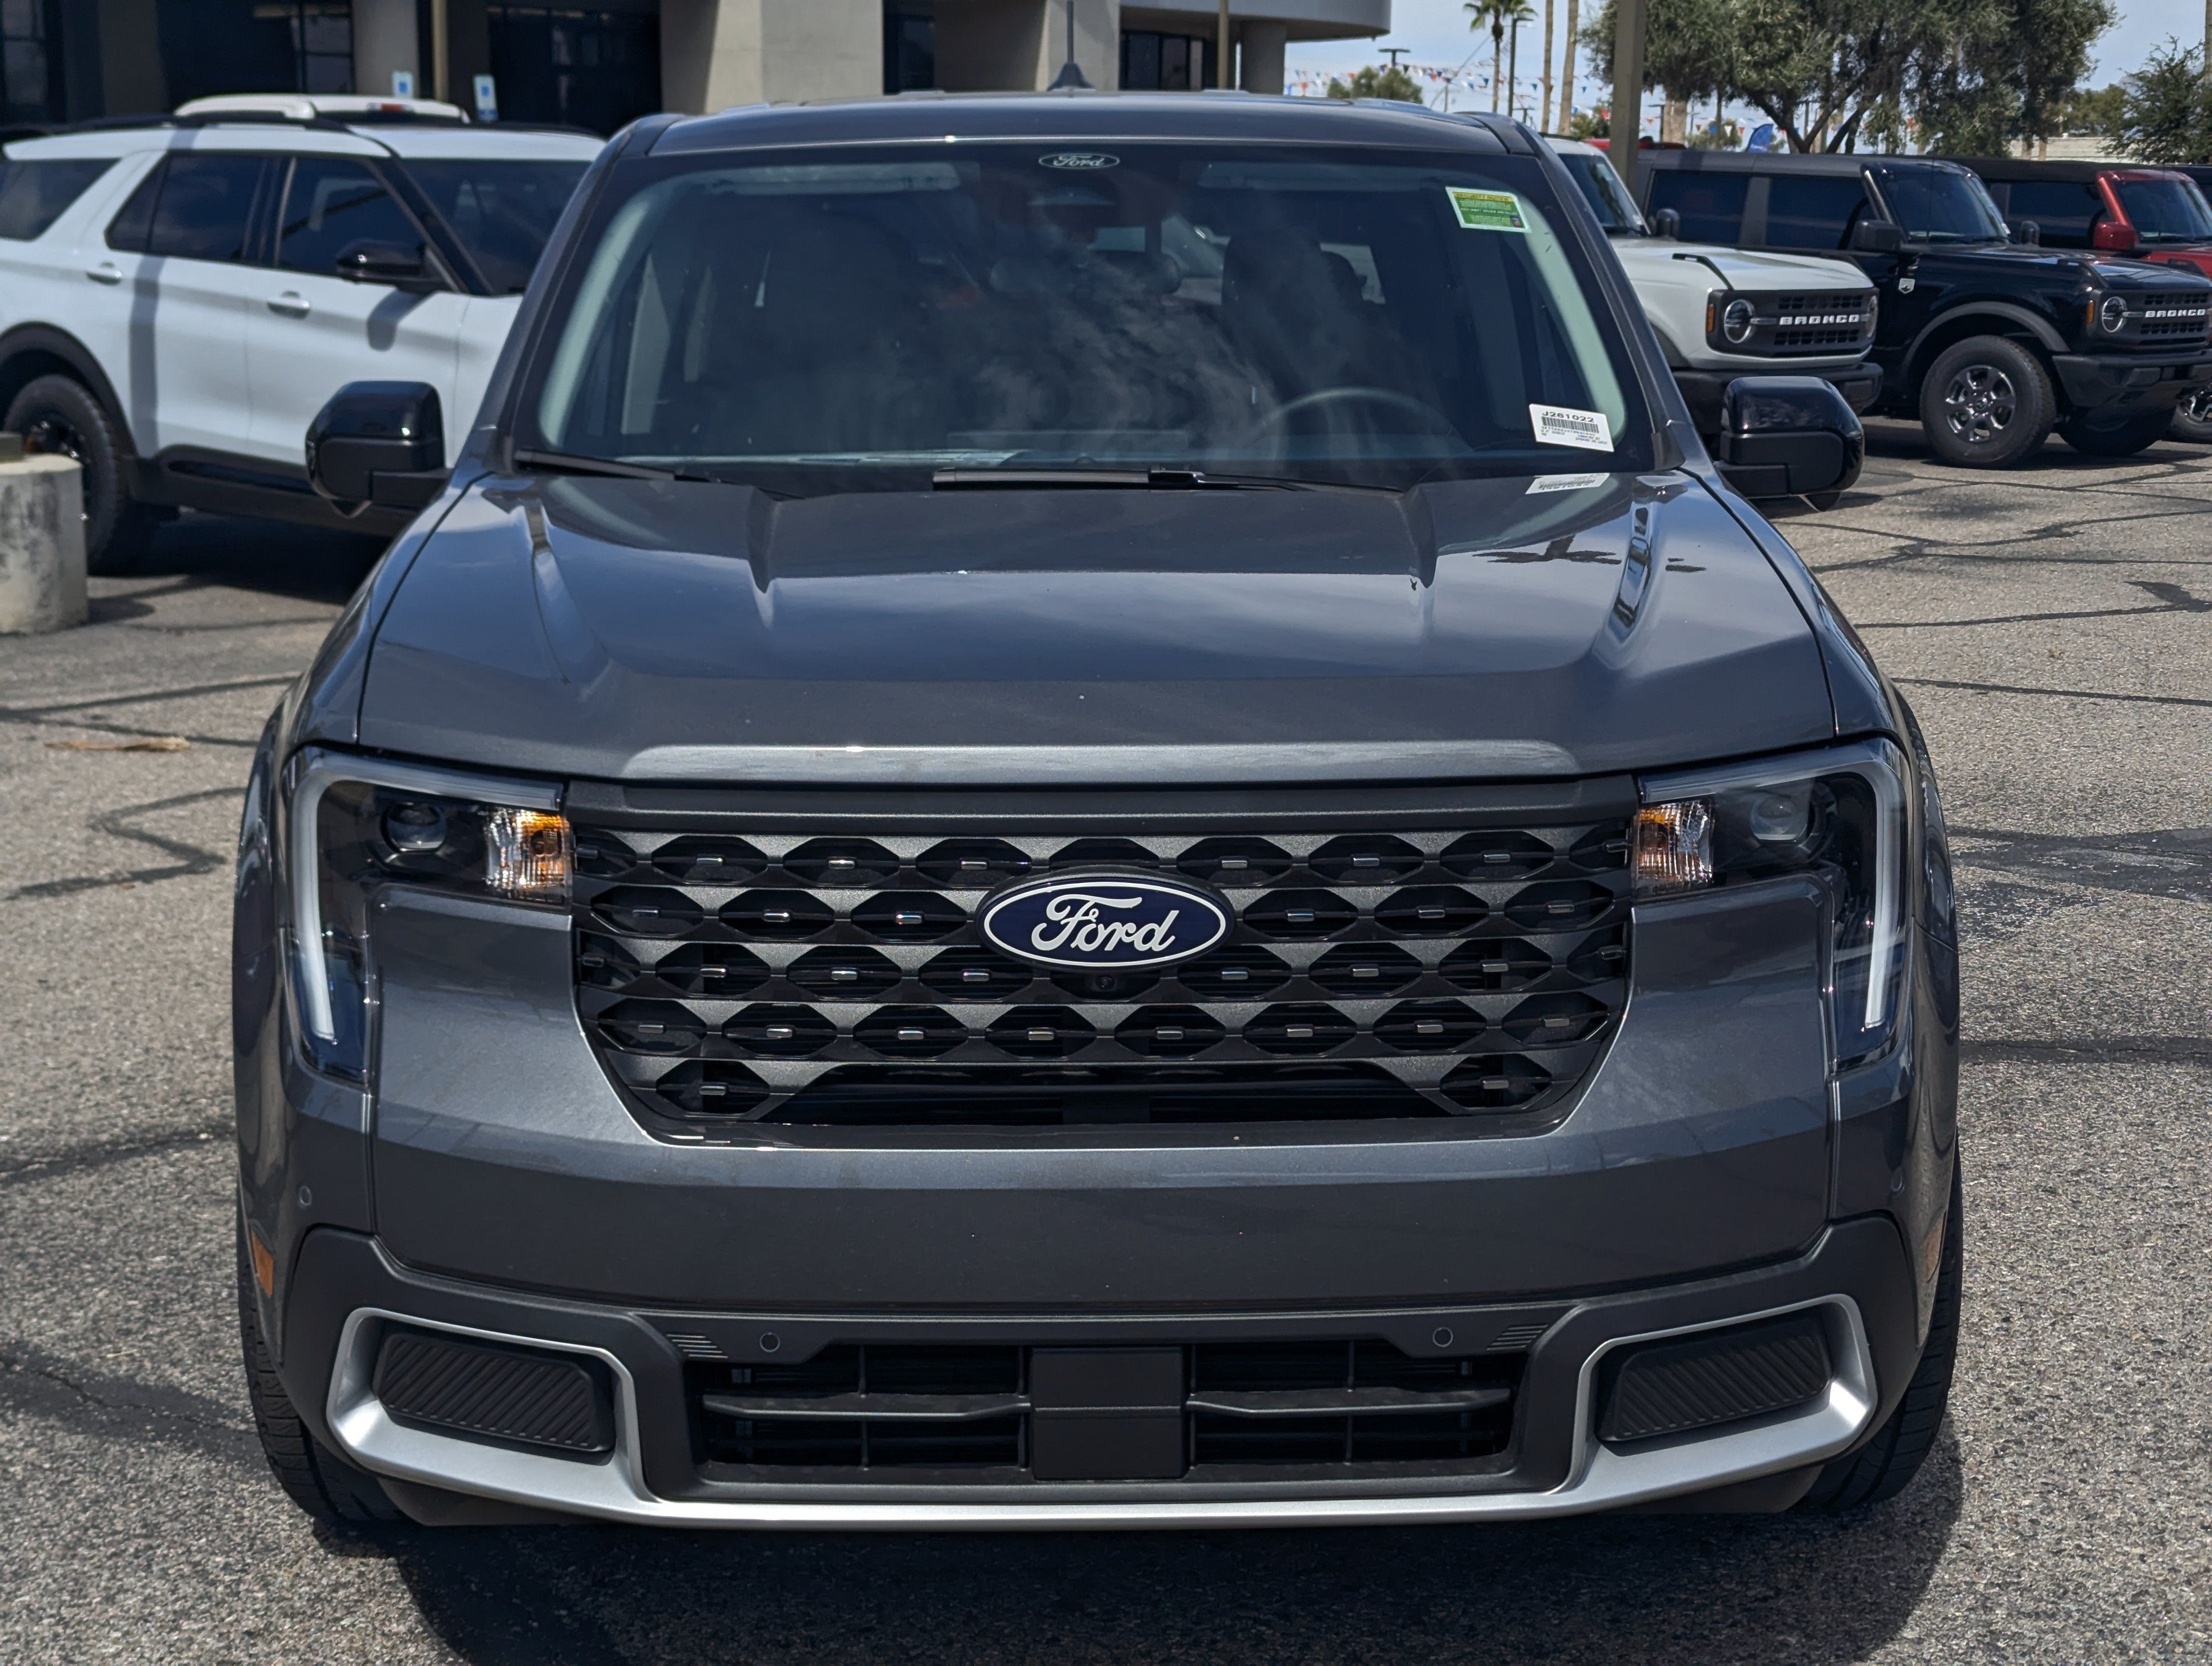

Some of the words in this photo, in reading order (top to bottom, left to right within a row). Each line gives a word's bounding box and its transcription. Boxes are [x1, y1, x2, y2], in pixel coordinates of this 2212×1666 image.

[1053, 154, 1105, 166] Ford
[2145, 309, 2205, 317] BRONCO
[1779, 315, 1860, 325] BRONCO
[1031, 893, 1180, 952] Ford
